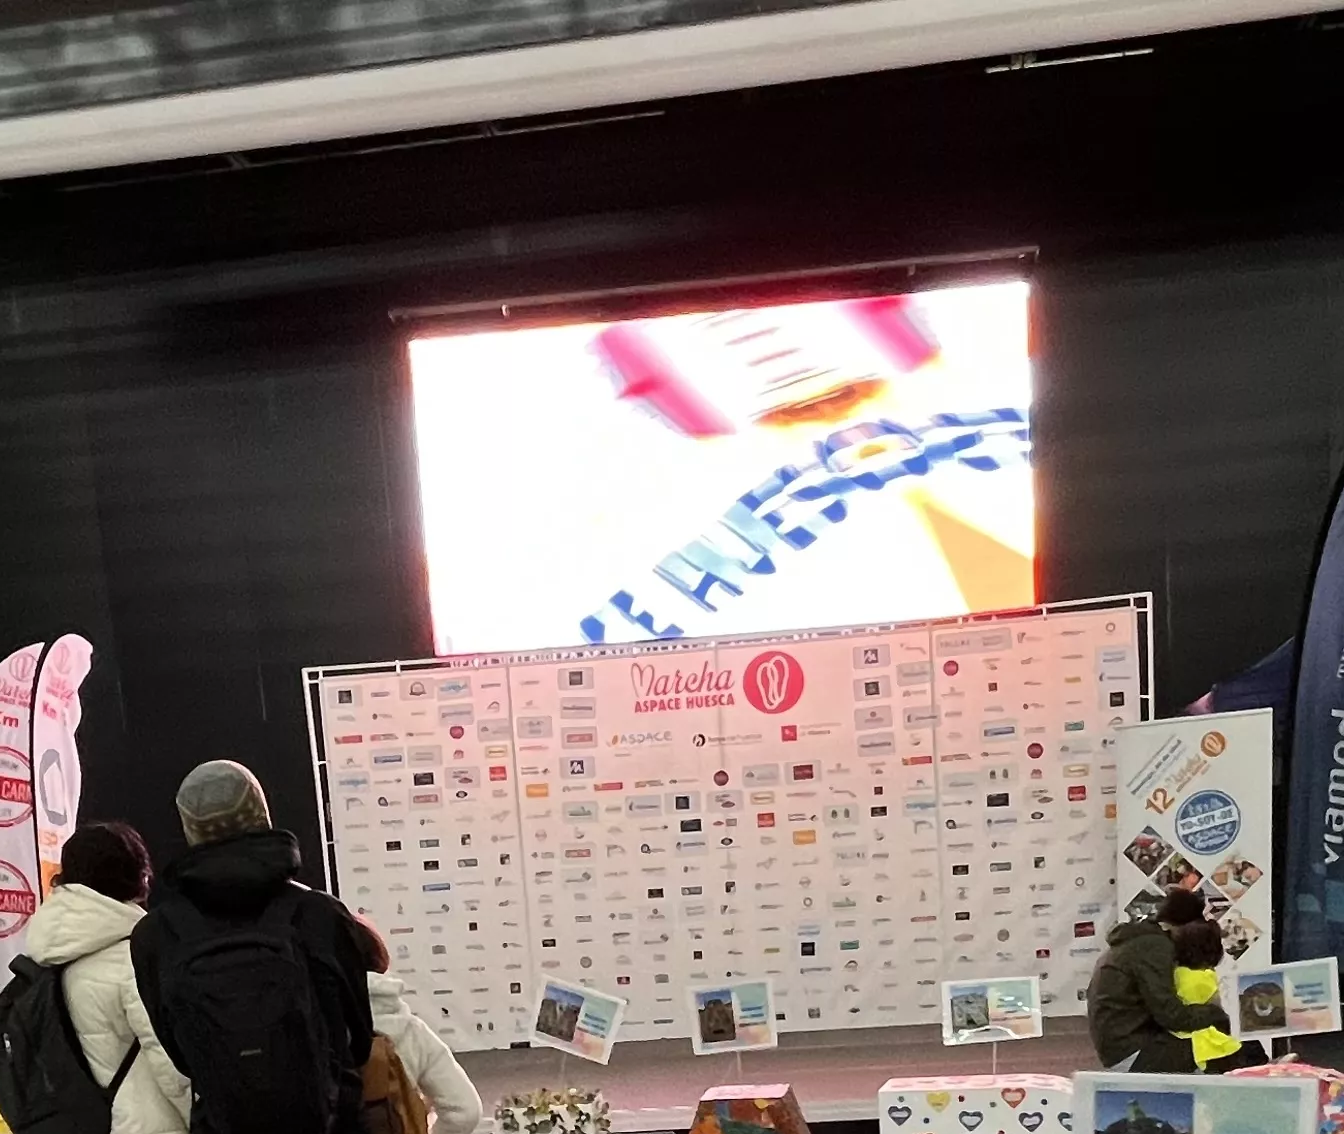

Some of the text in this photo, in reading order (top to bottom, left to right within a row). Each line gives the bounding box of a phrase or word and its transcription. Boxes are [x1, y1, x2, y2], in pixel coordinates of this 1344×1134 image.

[629, 661, 736, 698] Marcha
[634, 692, 736, 714] ASPACE HUESCA
[1144, 786, 1176, 815] 12
